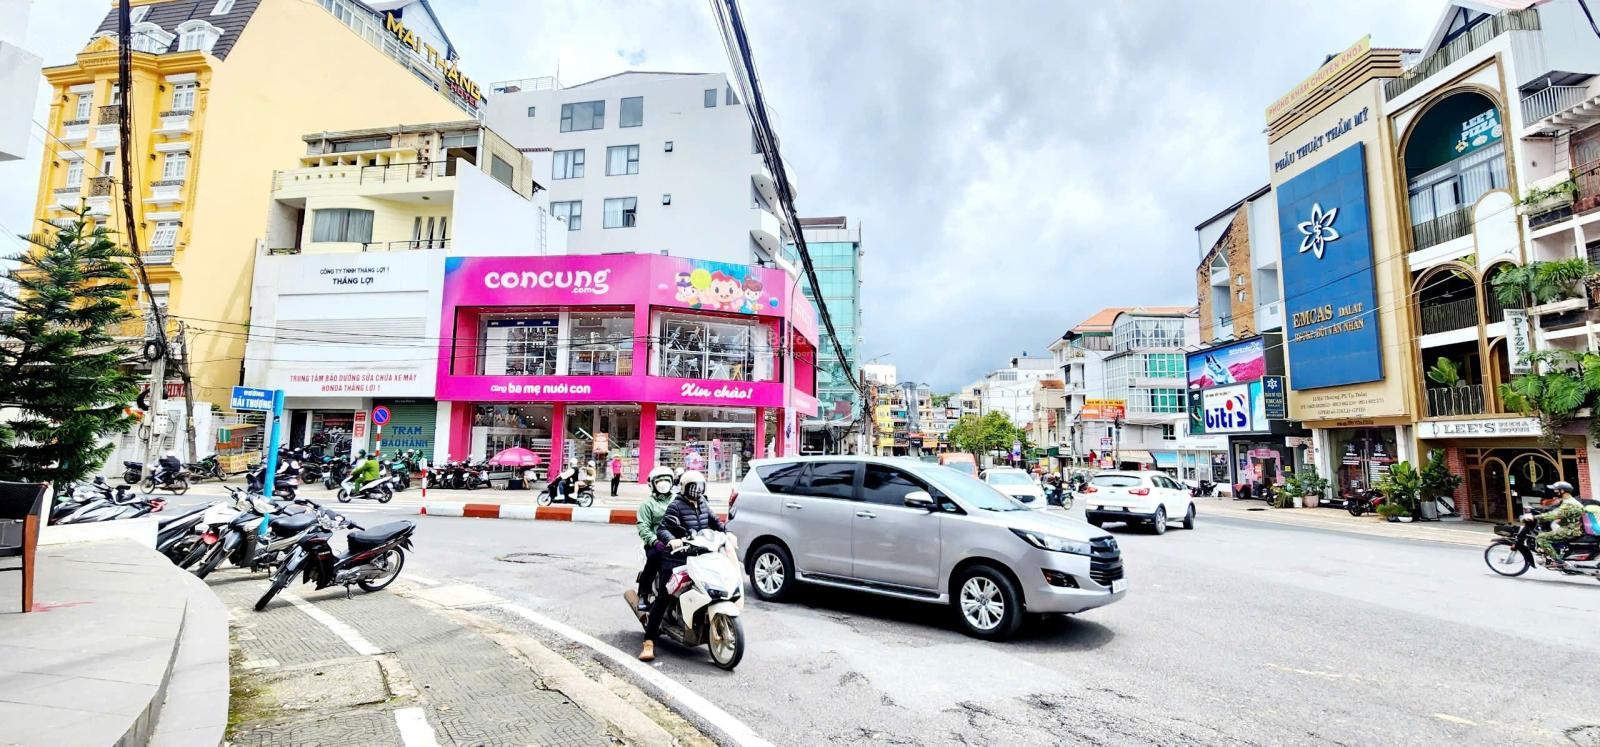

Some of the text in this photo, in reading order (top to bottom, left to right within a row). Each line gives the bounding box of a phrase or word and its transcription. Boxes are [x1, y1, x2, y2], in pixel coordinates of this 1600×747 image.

[386, 11, 420, 54] MAI
[1462, 108, 1495, 131] LEE'S
[1461, 117, 1497, 141] PIZZA
[484, 268, 612, 295] concung
[1293, 302, 1364, 329] EMCAS DALAT
[394, 373, 402, 381] XE
[321, 384, 342, 392] HONDA
[508, 382, 522, 394] ba
[523, 384, 541, 396] mẹ
[569, 384, 591, 394] con
[681, 382, 753, 399] Xin chào!
[392, 425, 423, 438] TRẠM
[1443, 422, 1496, 434] LEE'S
